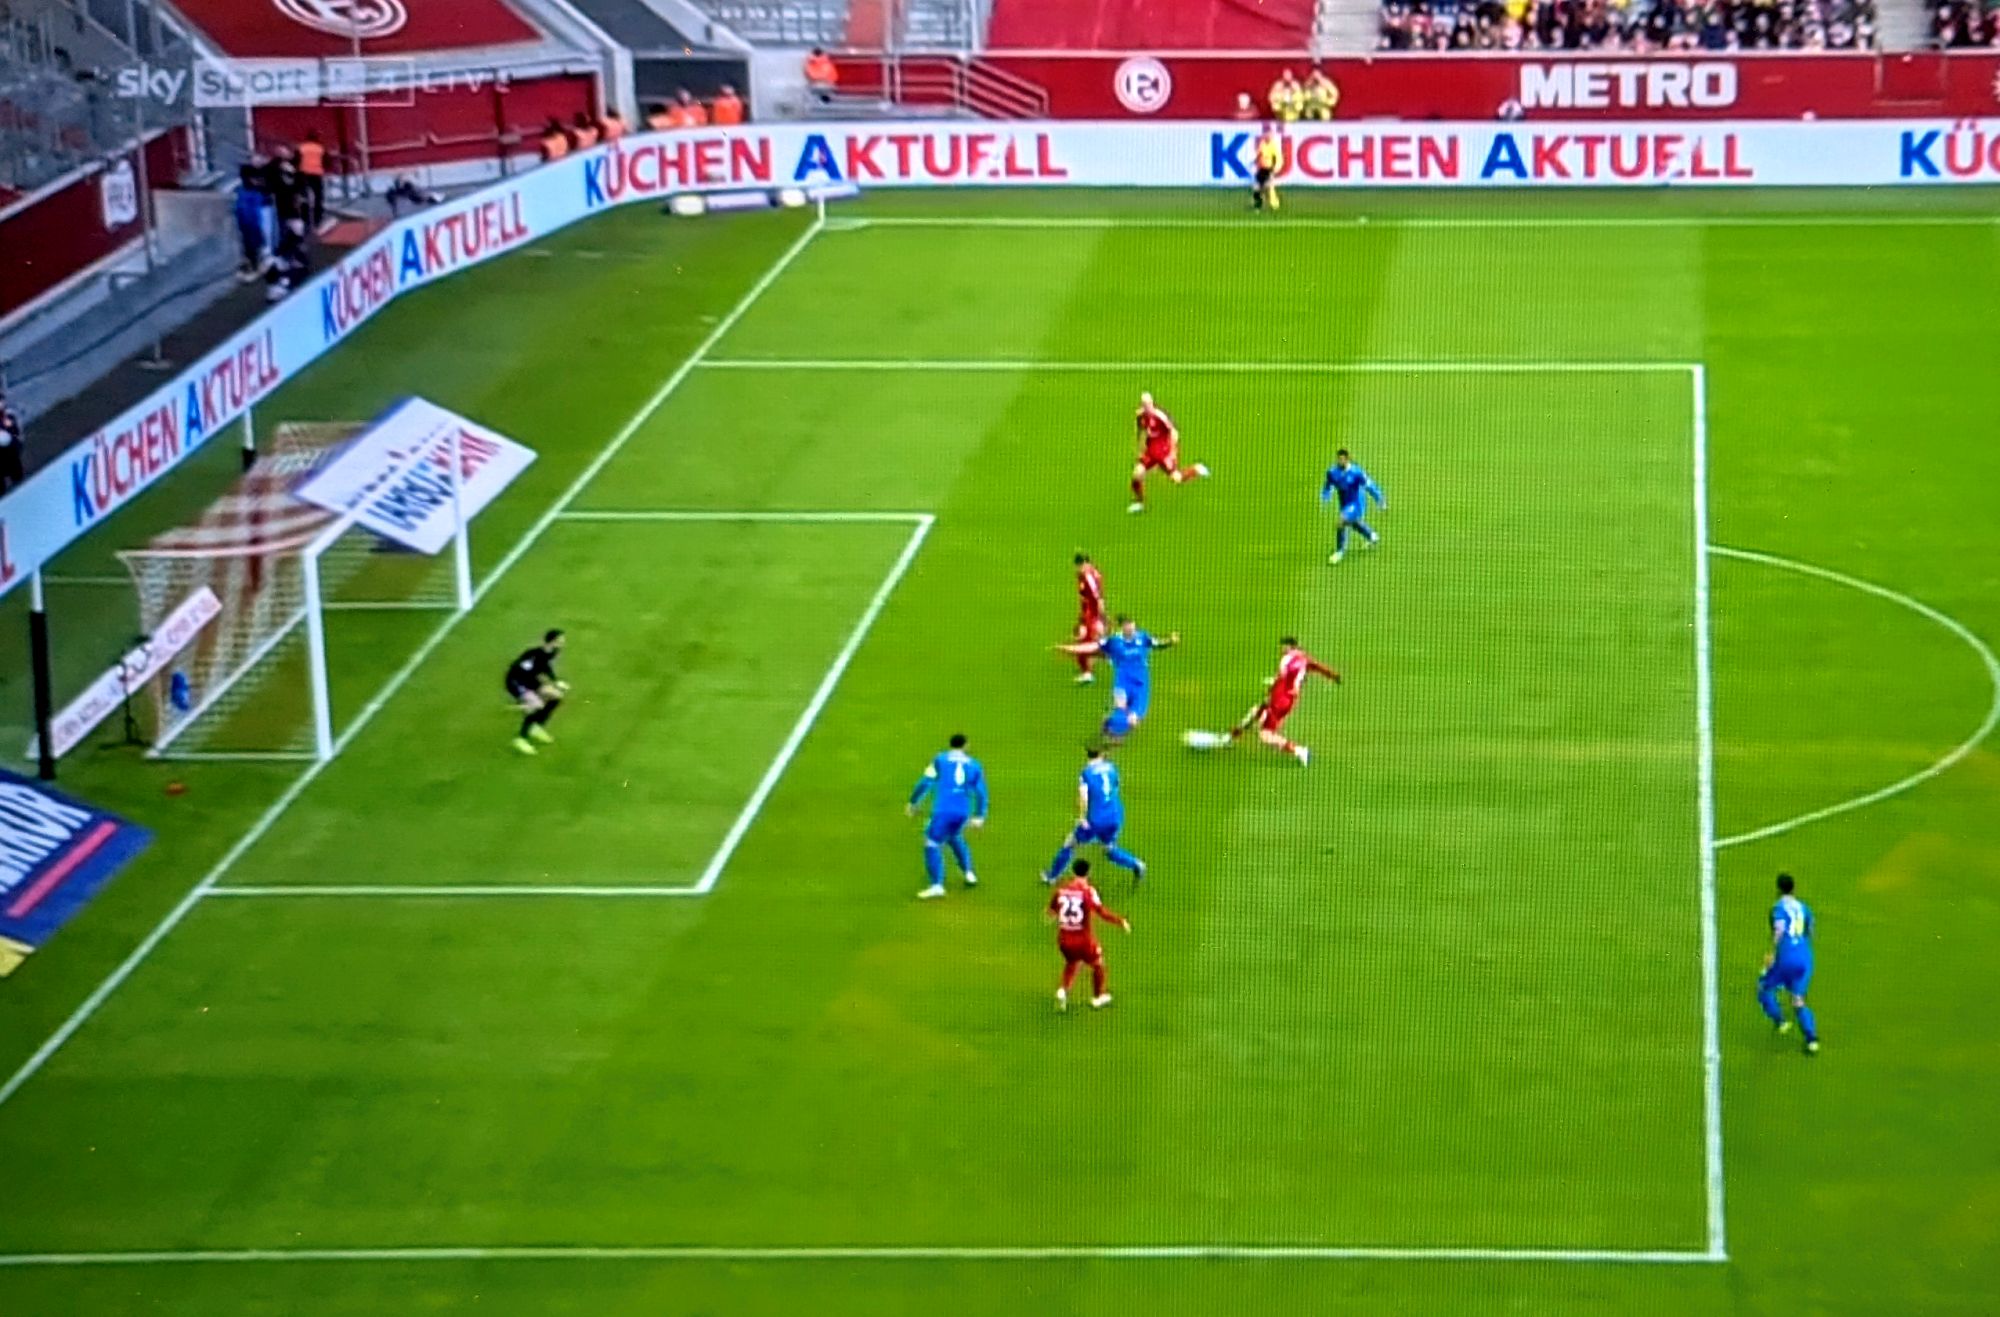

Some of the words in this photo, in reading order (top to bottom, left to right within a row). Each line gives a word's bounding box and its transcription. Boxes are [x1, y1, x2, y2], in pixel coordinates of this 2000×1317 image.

[1520, 63, 1738, 109] METRO
[584, 136, 771, 207] KÜCHEN
[793, 133, 1068, 181] AKTUELL
[1480, 132, 1754, 178] AKTUELL
[320, 241, 394, 342] KÜCHEN
[400, 191, 529, 284] AKTUELL
[70, 397, 180, 527] KÜCHEN
[184, 327, 280, 449] AKTUELL
[1057, 895, 1084, 923] 23
